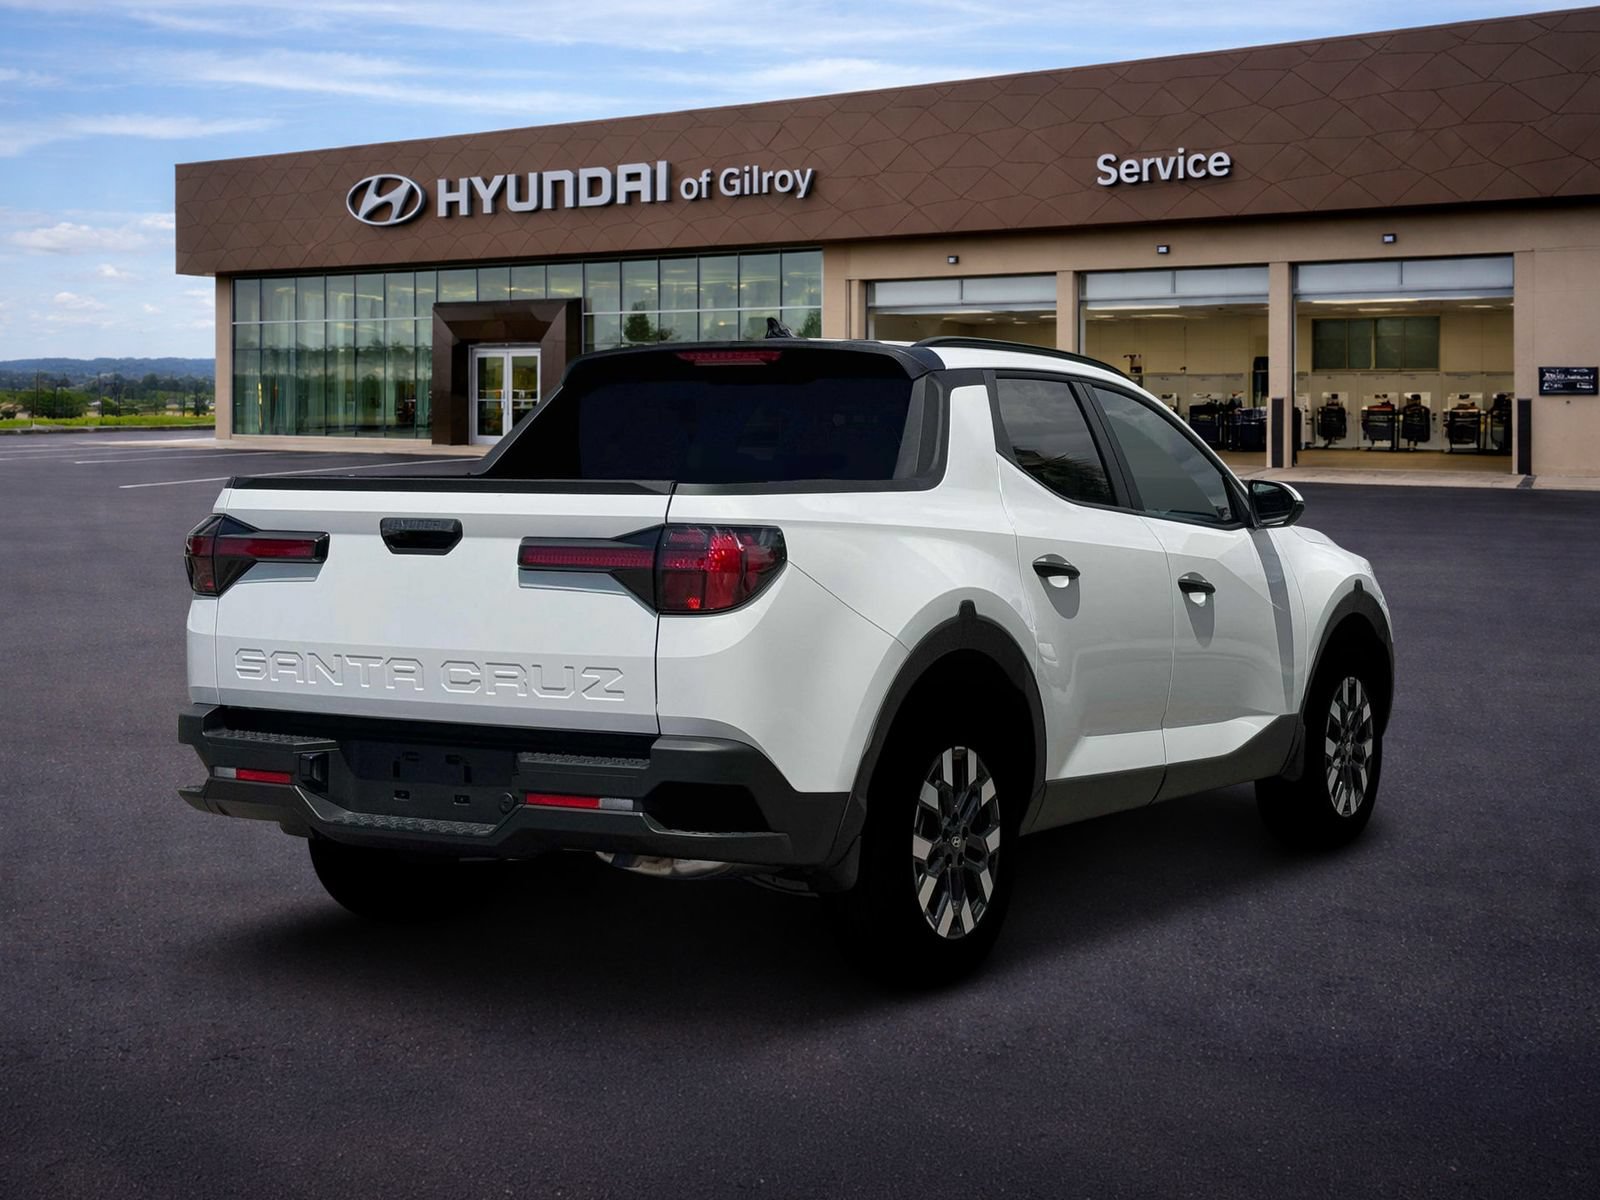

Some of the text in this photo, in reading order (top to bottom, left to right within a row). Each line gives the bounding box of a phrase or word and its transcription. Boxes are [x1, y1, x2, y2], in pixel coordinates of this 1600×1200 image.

[438, 160, 813, 217] HYUNDAI of Gilroy
[1097, 147, 1231, 185] Service
[235, 648, 625, 701] SANTA CRUZ
